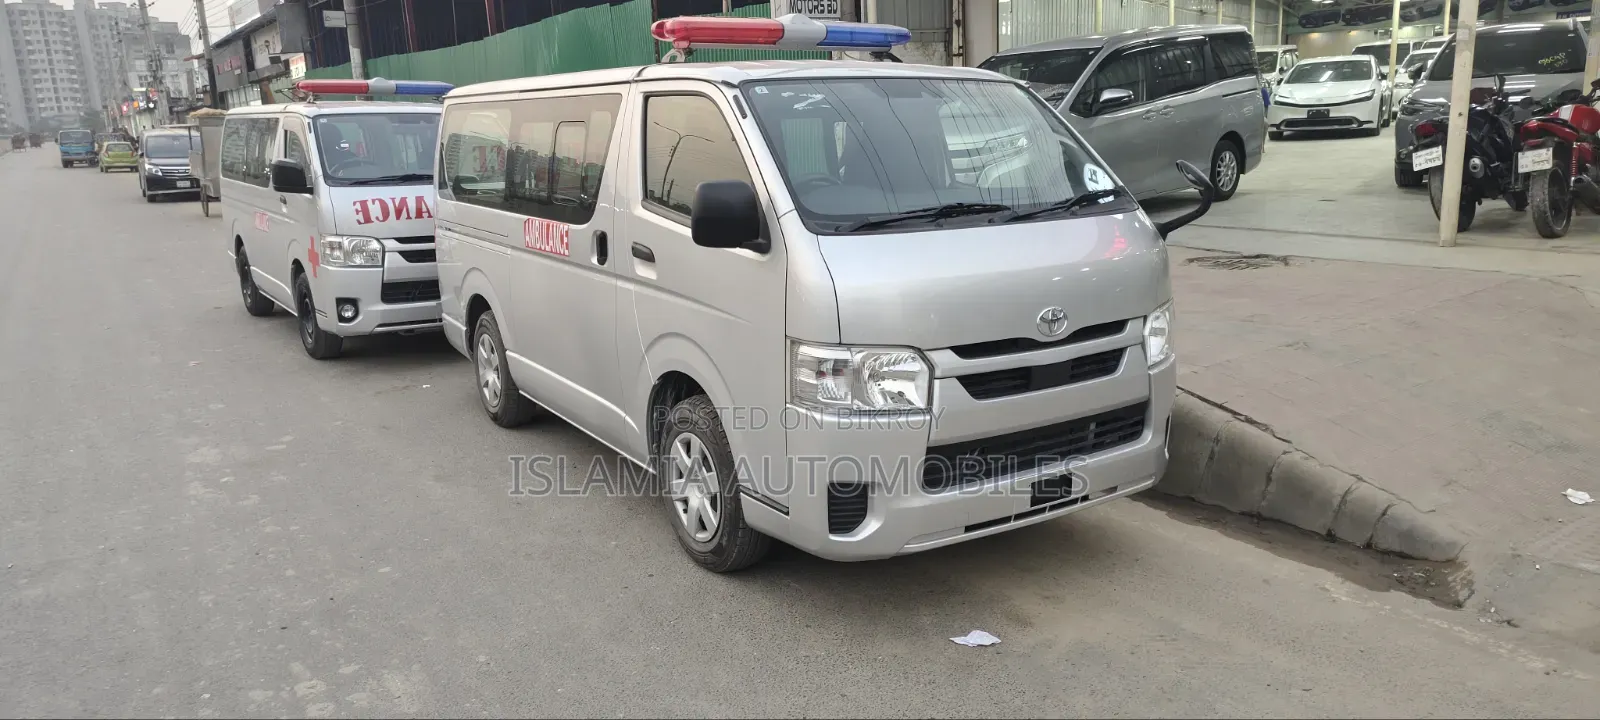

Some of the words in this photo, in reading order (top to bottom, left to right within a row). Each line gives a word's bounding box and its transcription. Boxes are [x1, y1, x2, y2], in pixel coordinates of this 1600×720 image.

[790, 0, 825, 14] MOTORS
[827, 0, 838, 14] BD
[525, 218, 569, 256] AMBULANCE
